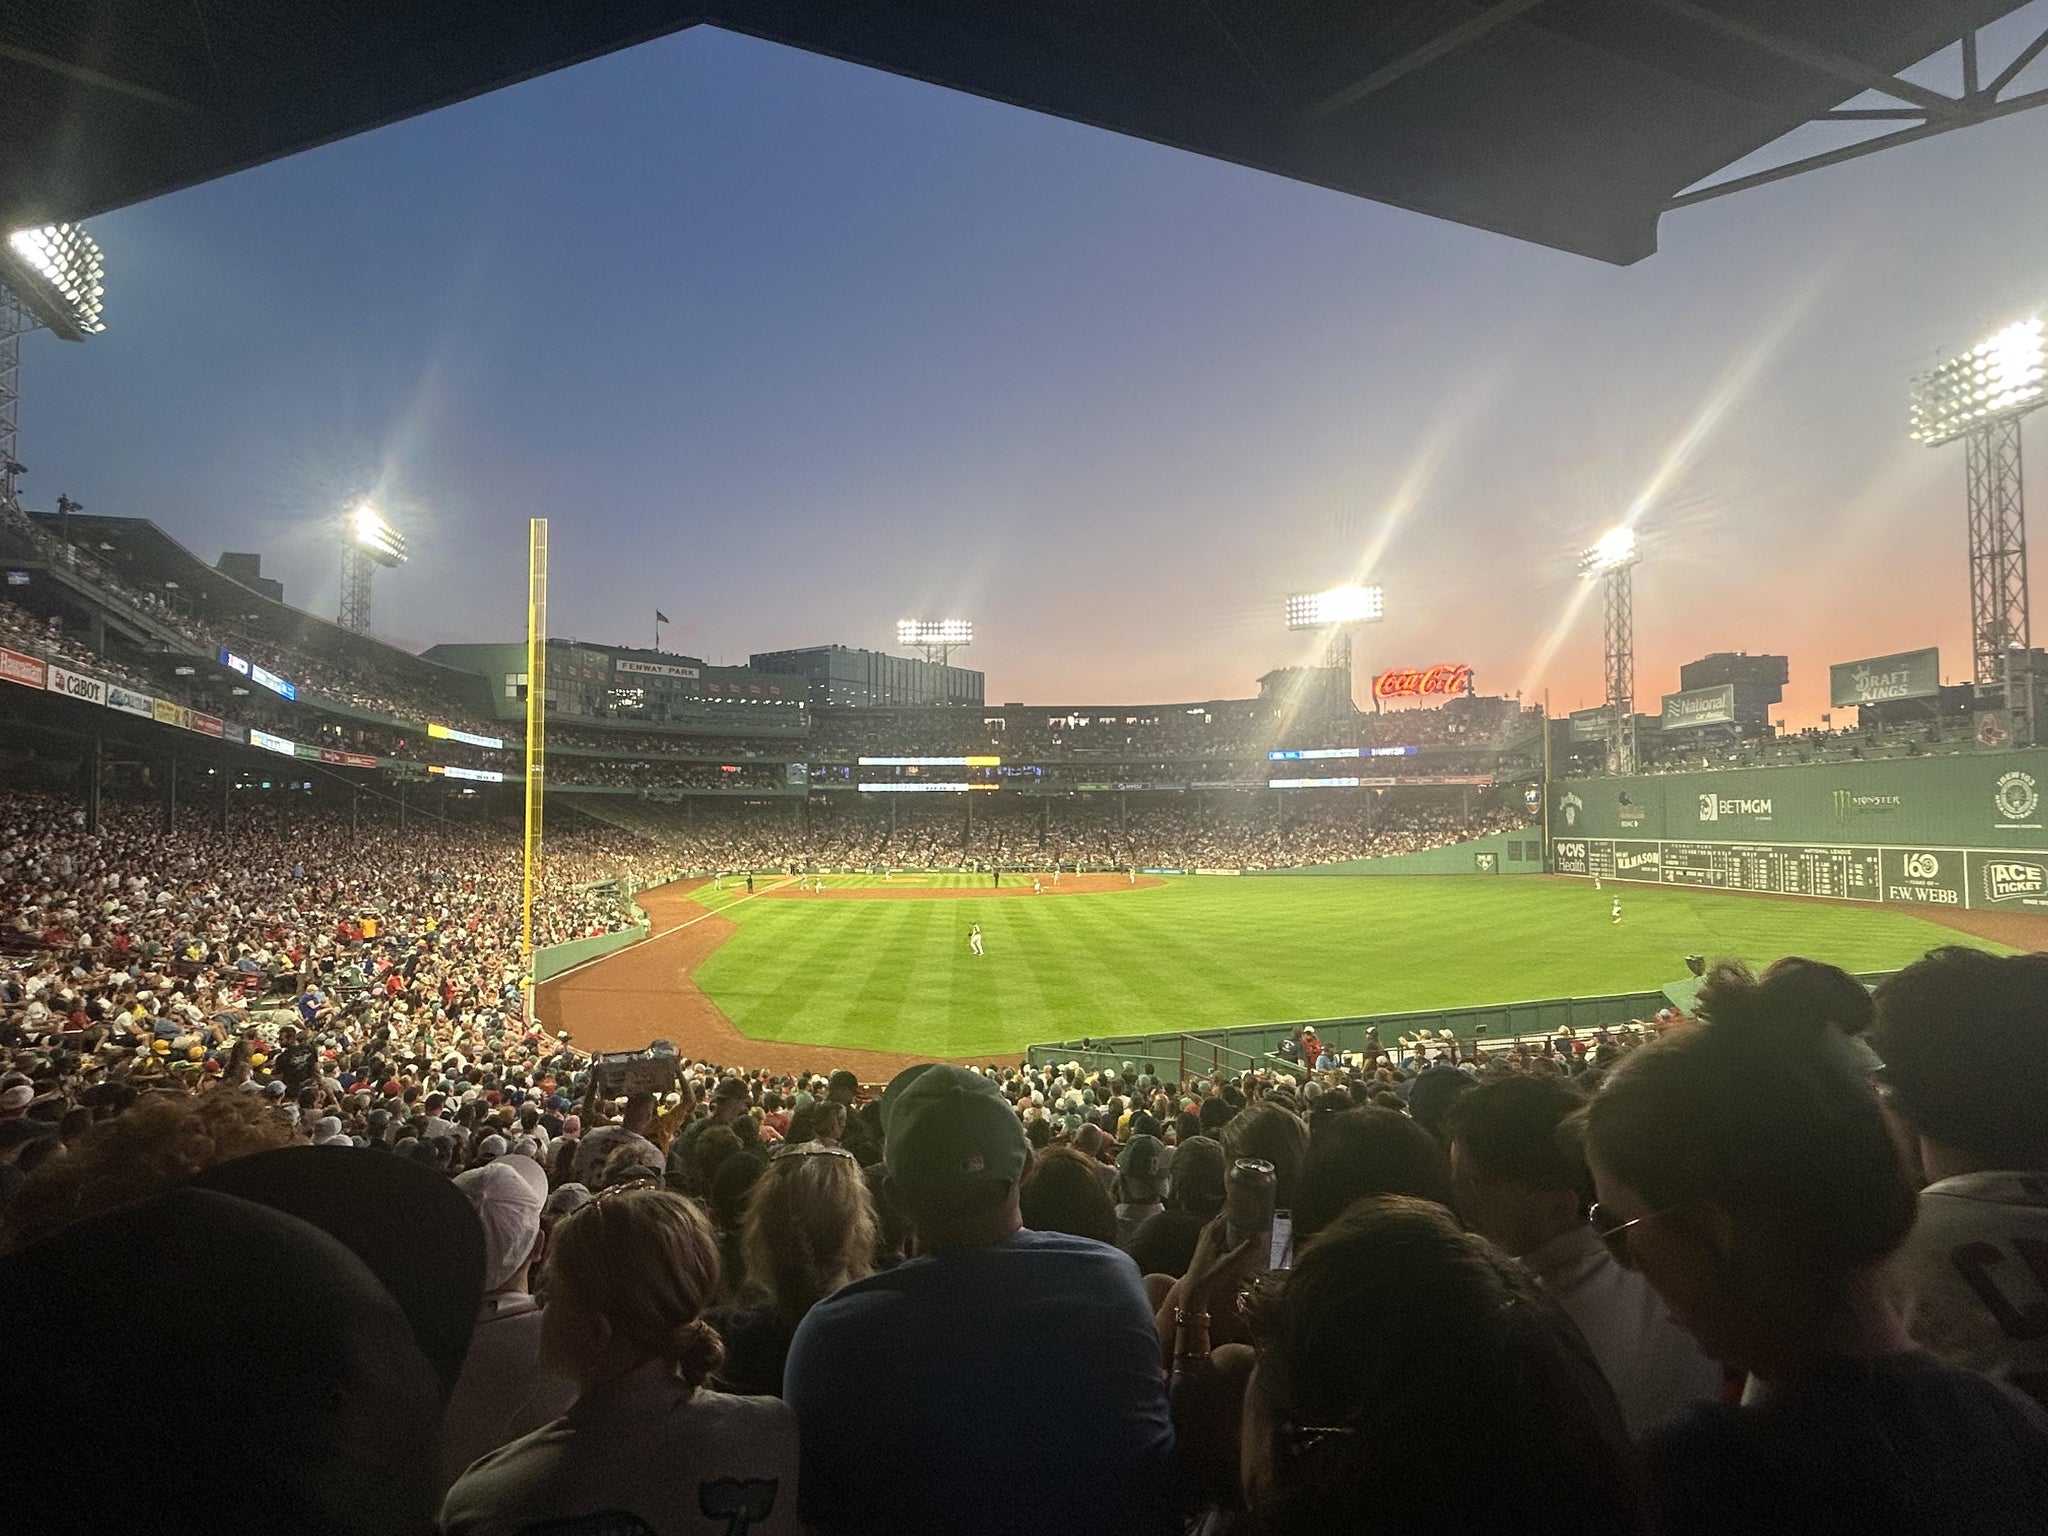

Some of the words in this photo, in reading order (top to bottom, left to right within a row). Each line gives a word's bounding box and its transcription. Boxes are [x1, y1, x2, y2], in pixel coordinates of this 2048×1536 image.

[621, 662, 663, 673] FENWAY
[669, 667, 695, 676] PARK
[1855, 669, 1910, 692] DRAFT
[1861, 684, 1908, 700] KINGS
[1681, 693, 1726, 714] National
[1996, 771, 2020, 787] IBEW
[2020, 772, 2036, 787] 103
[1719, 799, 1772, 814] BETMGM
[1852, 795, 1901, 805] MONSTER
[1566, 842, 1585, 858] CVS
[1558, 857, 1586, 873] Health
[1903, 853, 1939, 878] 160
[1996, 864, 2042, 882] ACE
[1889, 886, 1912, 900] F.W.
[1915, 888, 1958, 904] WEBB
[1997, 881, 2042, 893] TICKET
